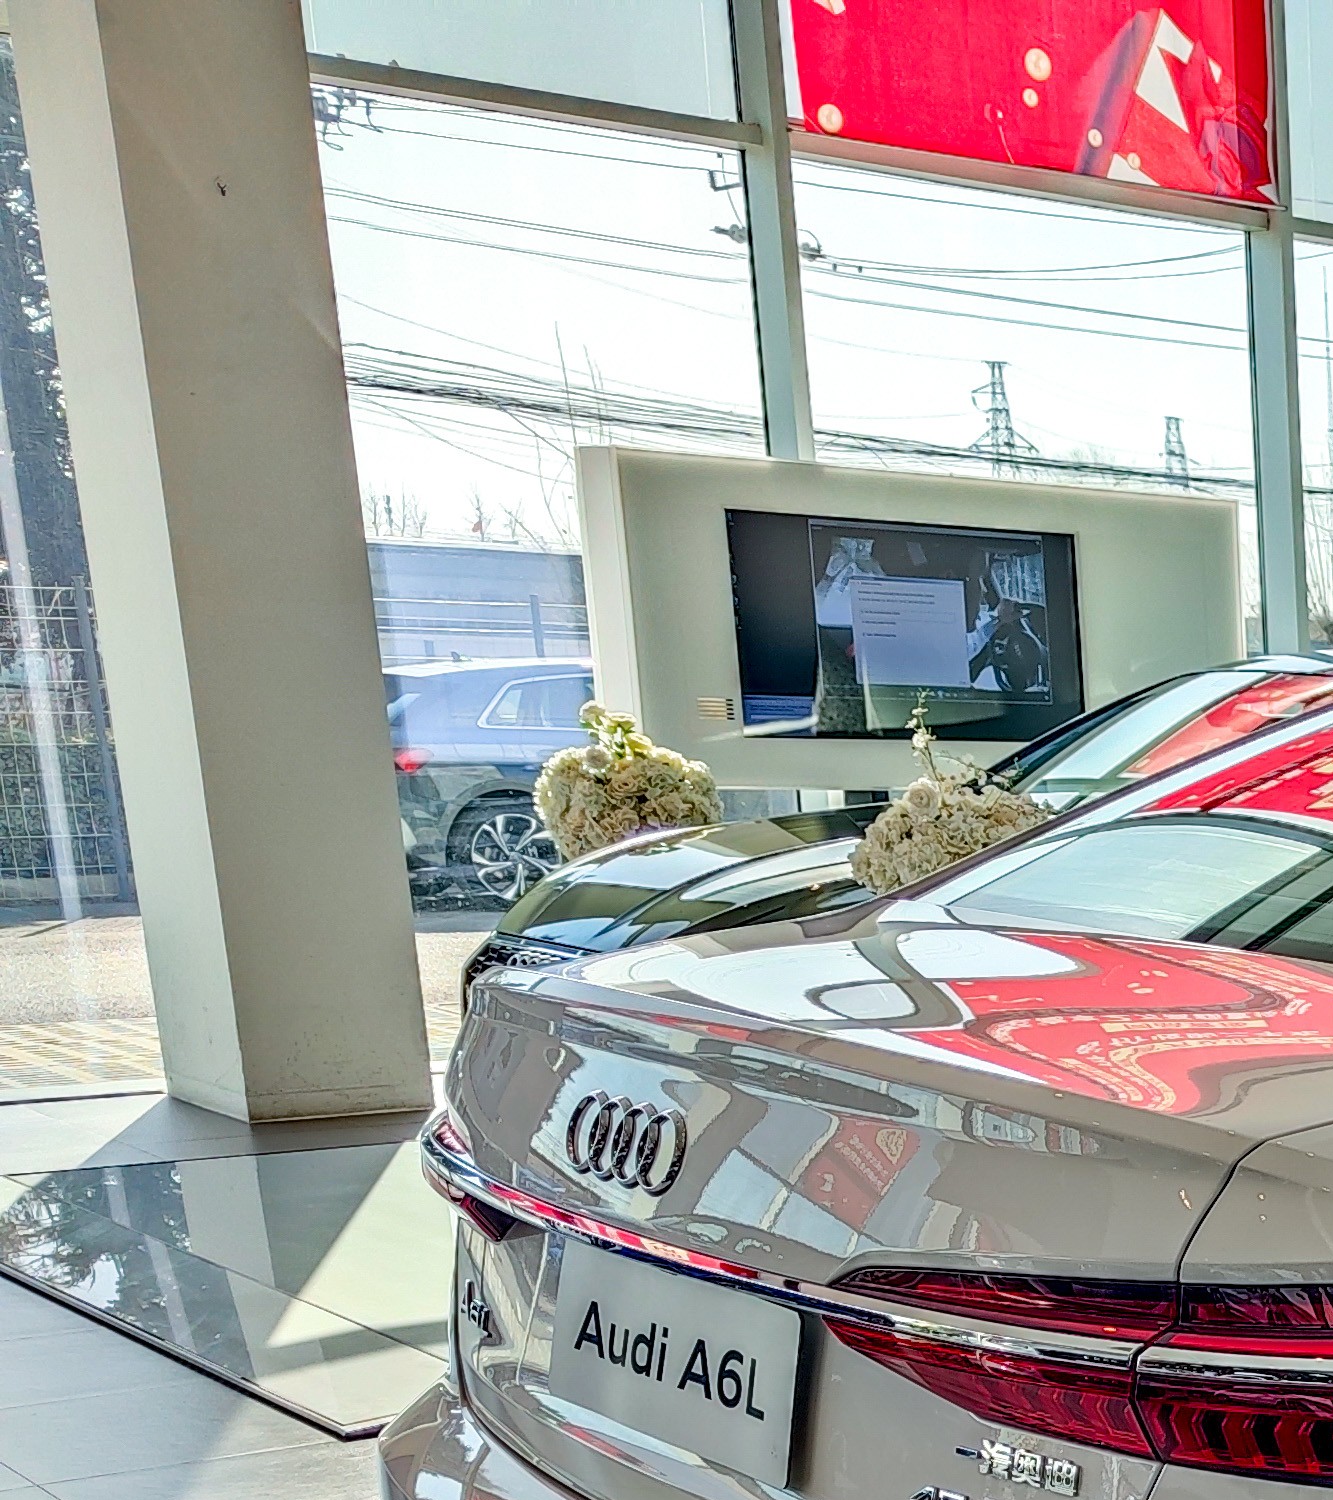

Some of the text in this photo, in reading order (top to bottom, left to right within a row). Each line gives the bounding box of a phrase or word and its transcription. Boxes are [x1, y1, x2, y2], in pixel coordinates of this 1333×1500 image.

[573, 1300, 765, 1422] Audi A6L
[955, 1438, 1082, 1496] 一汽奥迪
